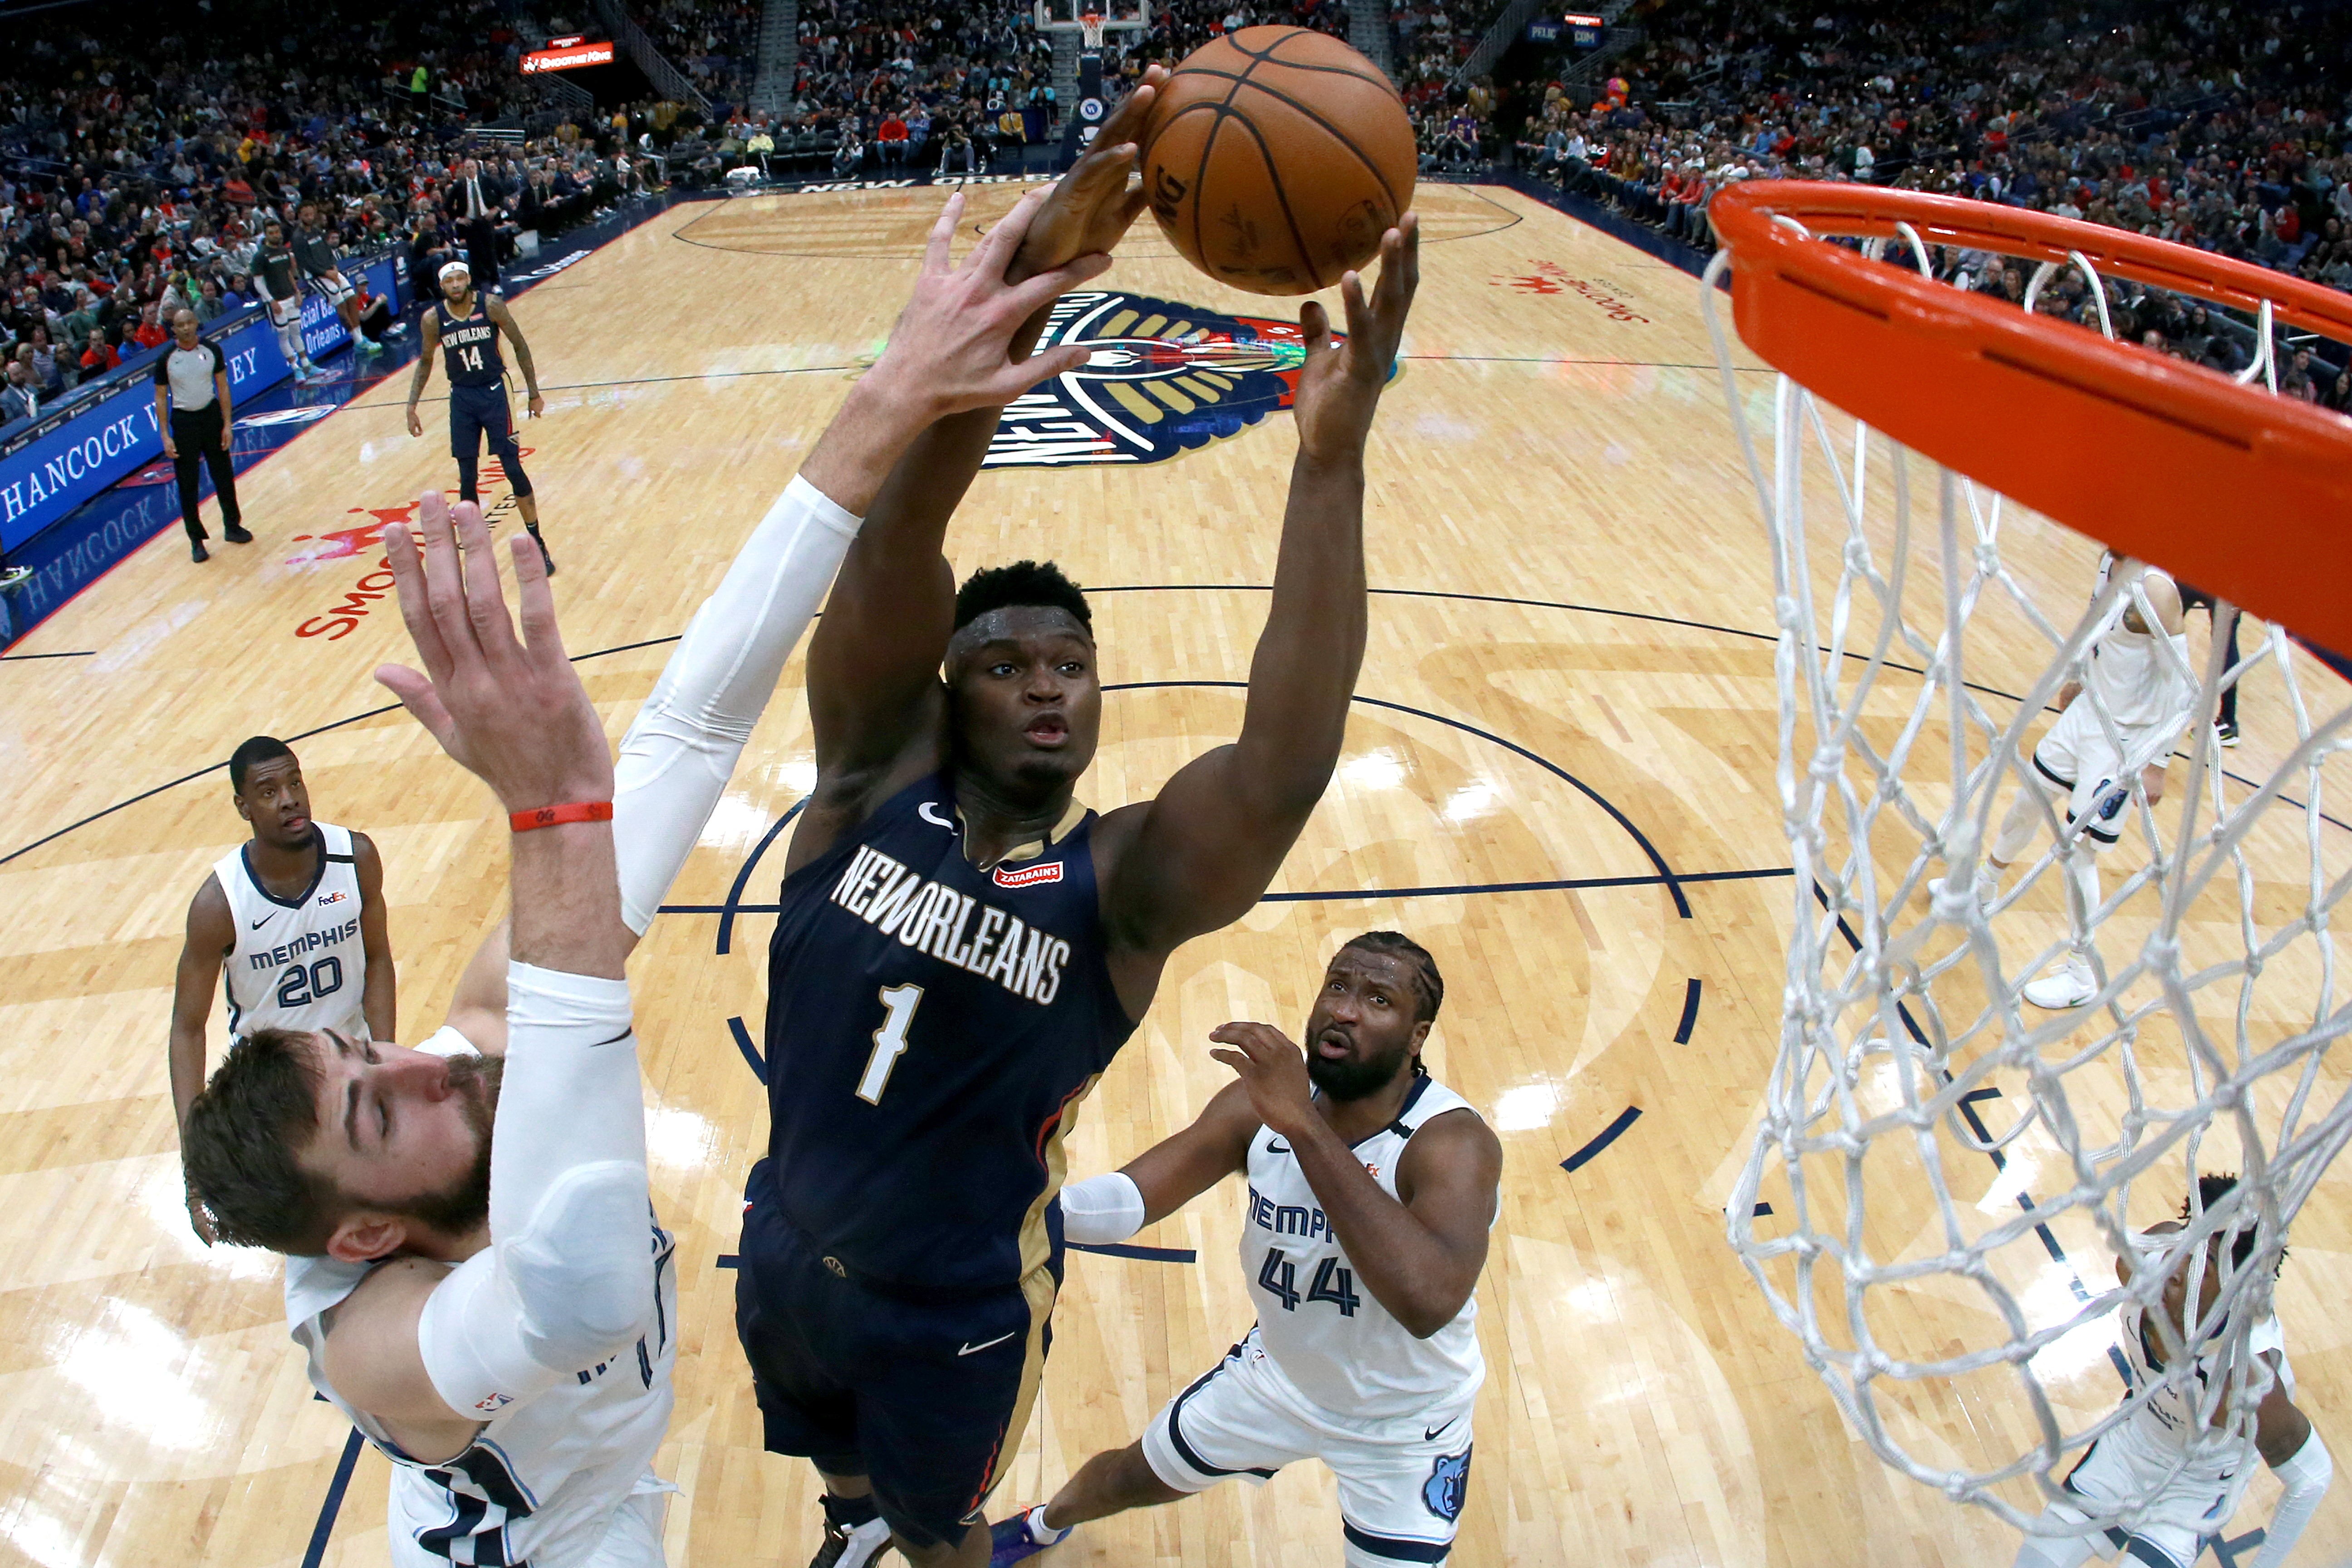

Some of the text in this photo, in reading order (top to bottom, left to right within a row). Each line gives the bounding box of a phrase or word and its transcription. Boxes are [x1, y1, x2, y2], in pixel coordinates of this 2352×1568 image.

[801, 180, 916, 194] NEW
[306, 323, 341, 354] Orleans
[441, 326, 491, 348] NEW ORLEANS
[458, 345, 484, 372] 14
[0, 413, 139, 523] HANCOCK
[1000, 867, 1058, 882] ZATARAIN'S
[318, 892, 347, 906] FedEx
[250, 918, 358, 970] MEMPHIS
[899, 880, 1072, 1006] ORLEANS
[277, 956, 343, 1008] 20
[855, 982, 925, 1107] 1
[1258, 1247, 1360, 1318] 44
